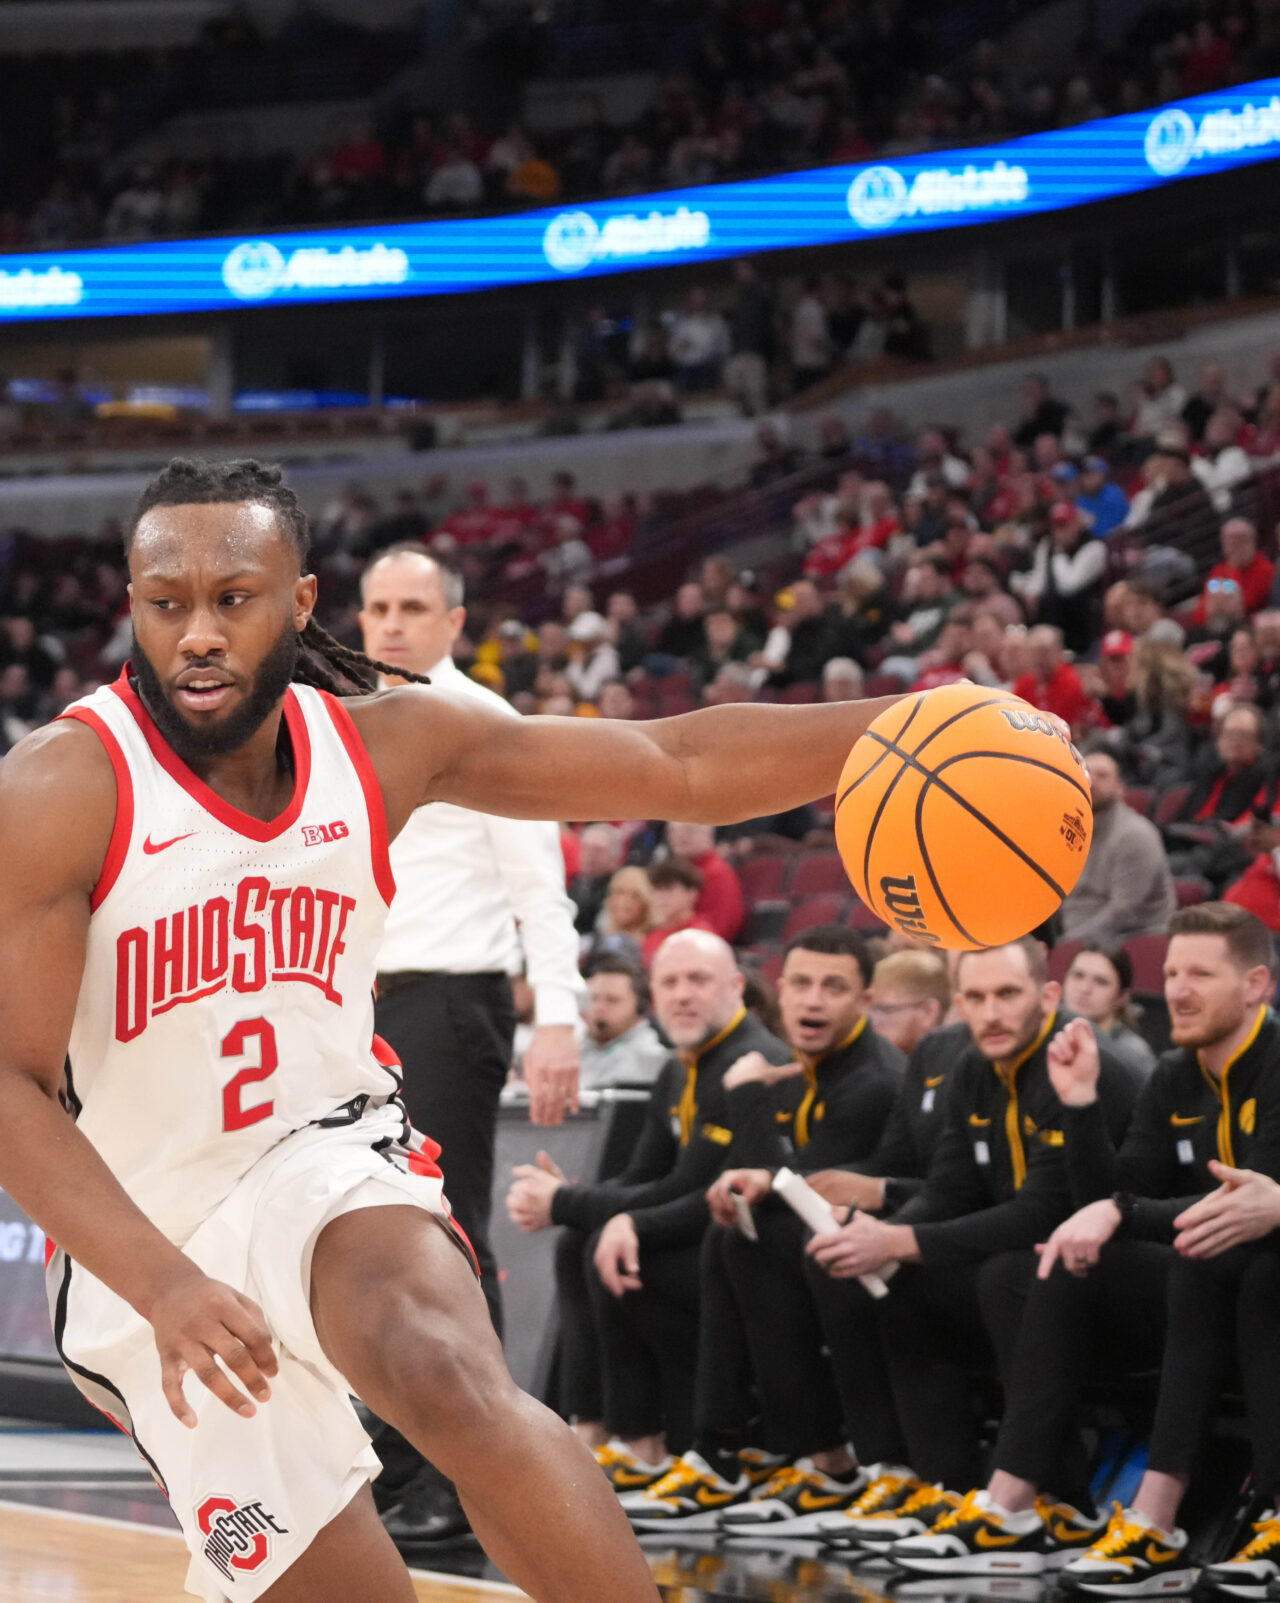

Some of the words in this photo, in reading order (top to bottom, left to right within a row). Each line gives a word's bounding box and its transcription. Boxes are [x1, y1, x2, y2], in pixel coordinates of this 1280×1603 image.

[1193, 96, 1280, 160] Allstat
[904, 160, 1028, 217] Allstate
[594, 206, 710, 259] Allstate
[282, 243, 408, 289] Allstate
[220, 1016, 278, 1132] 2
